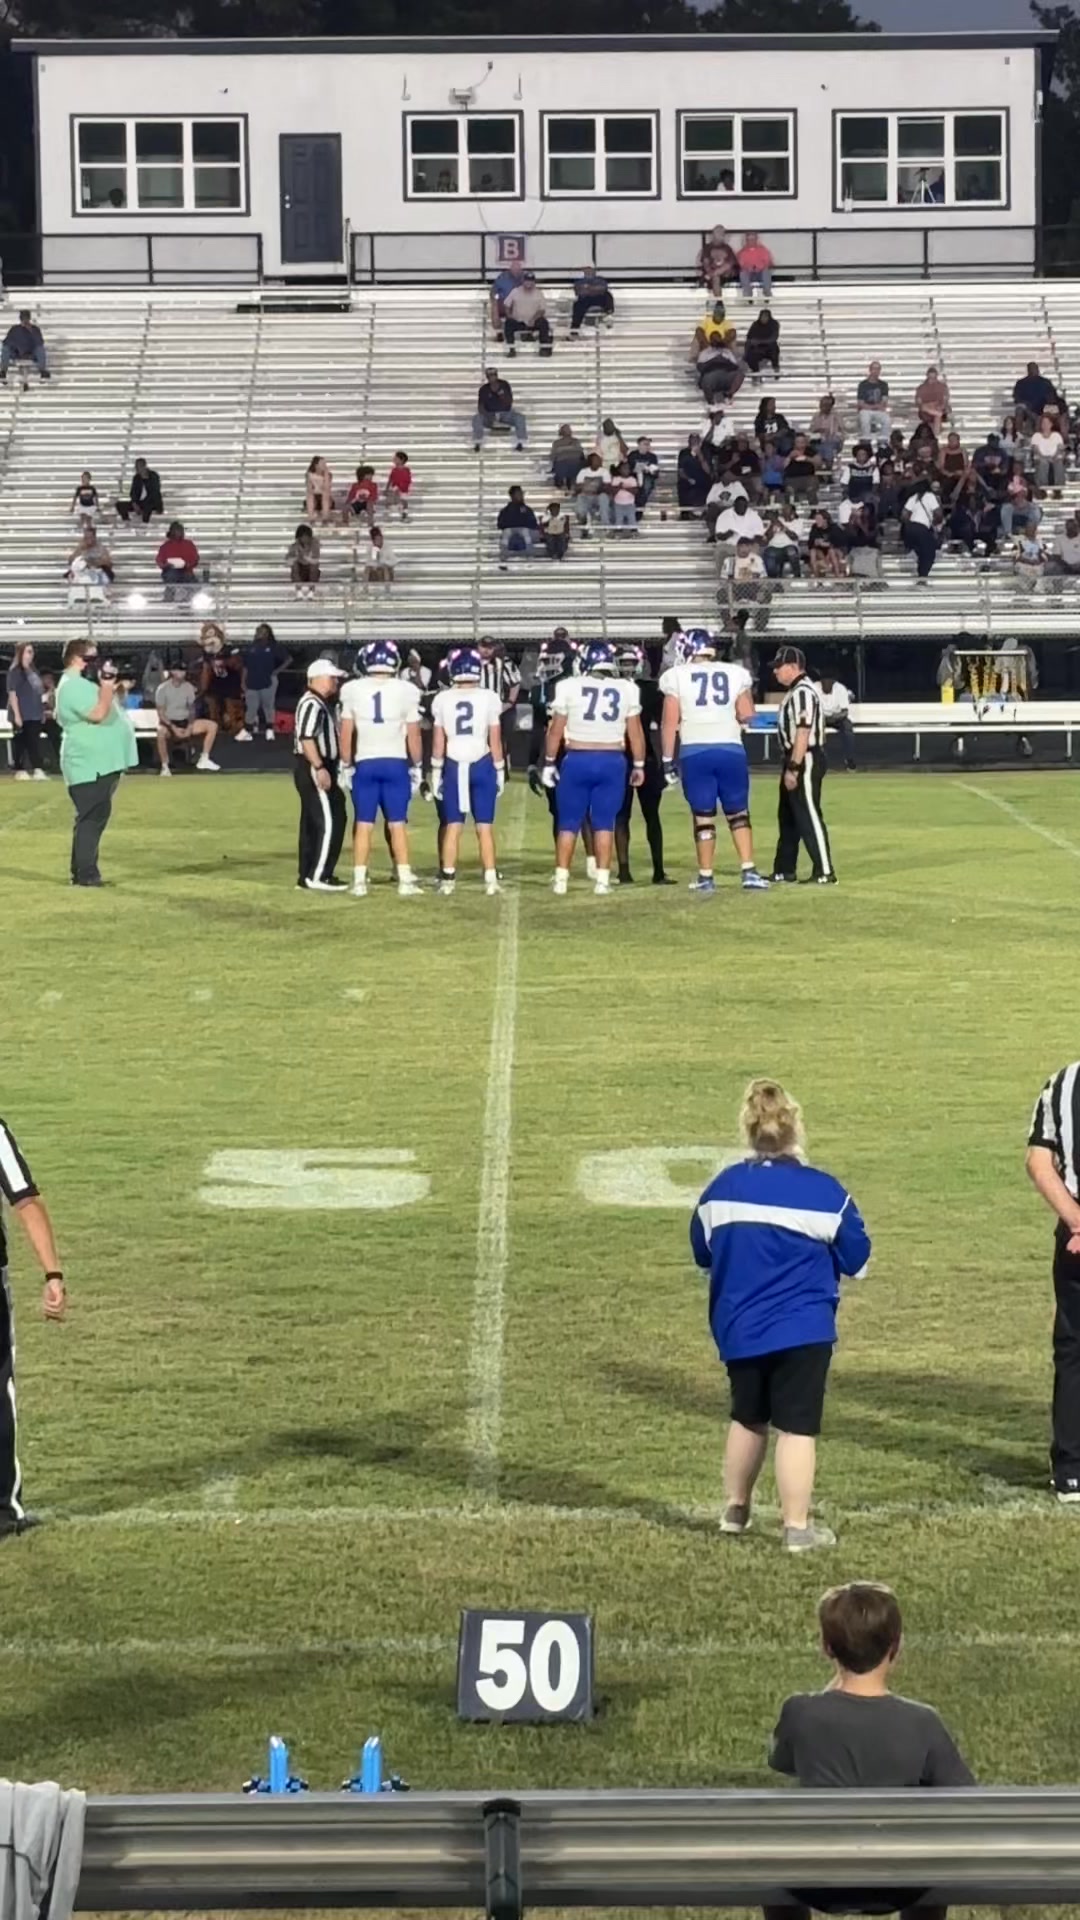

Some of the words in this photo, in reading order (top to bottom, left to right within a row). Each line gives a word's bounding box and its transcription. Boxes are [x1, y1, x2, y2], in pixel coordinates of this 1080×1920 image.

[504, 239, 520, 259] B
[581, 687, 620, 722] 73
[691, 671, 730, 706] 79
[372, 691, 384, 723] 1
[455, 701, 474, 735] 2
[475, 1619, 580, 1712] 50
